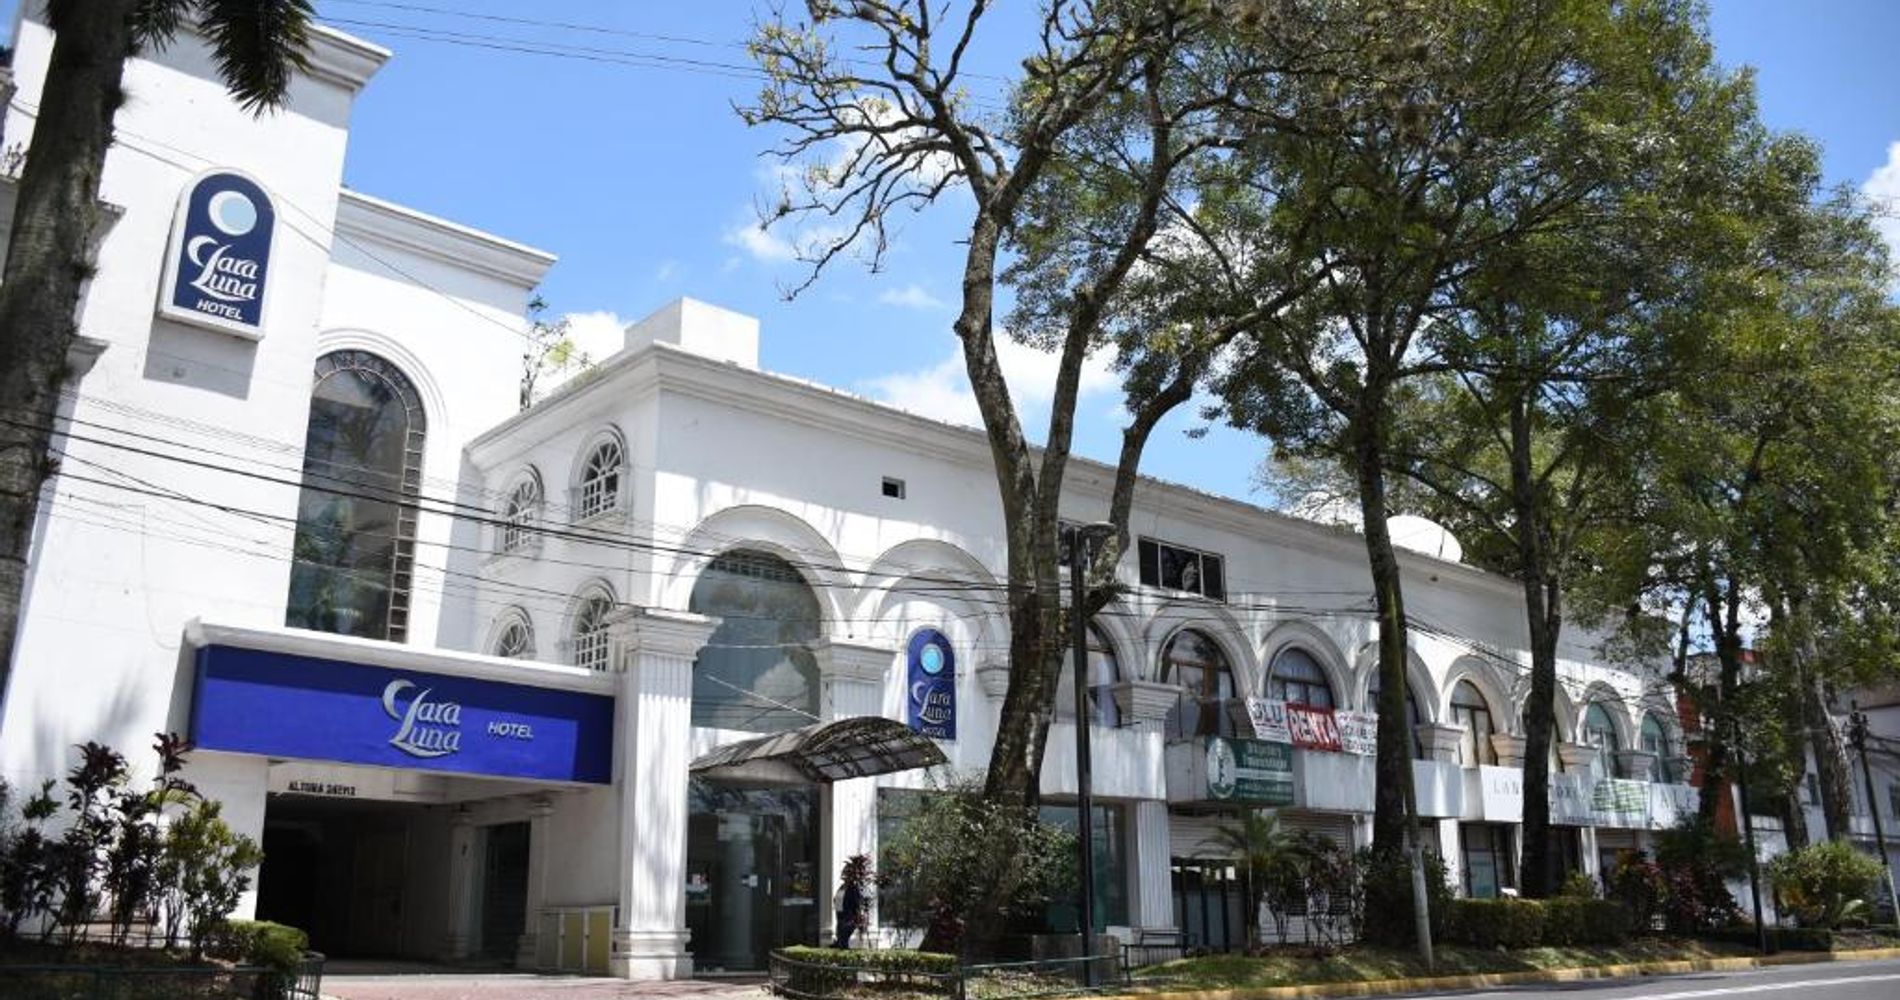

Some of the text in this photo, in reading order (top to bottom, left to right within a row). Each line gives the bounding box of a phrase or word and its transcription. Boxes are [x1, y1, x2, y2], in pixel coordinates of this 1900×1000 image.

[187, 235, 258, 280] Clara
[190, 262, 258, 302] Luna
[196, 299, 243, 320] HOTEL
[382, 679, 462, 725] Clara
[389, 714, 461, 757] Luna
[487, 721, 534, 739] HOTEL
[1288, 708, 1341, 744] RENTA
